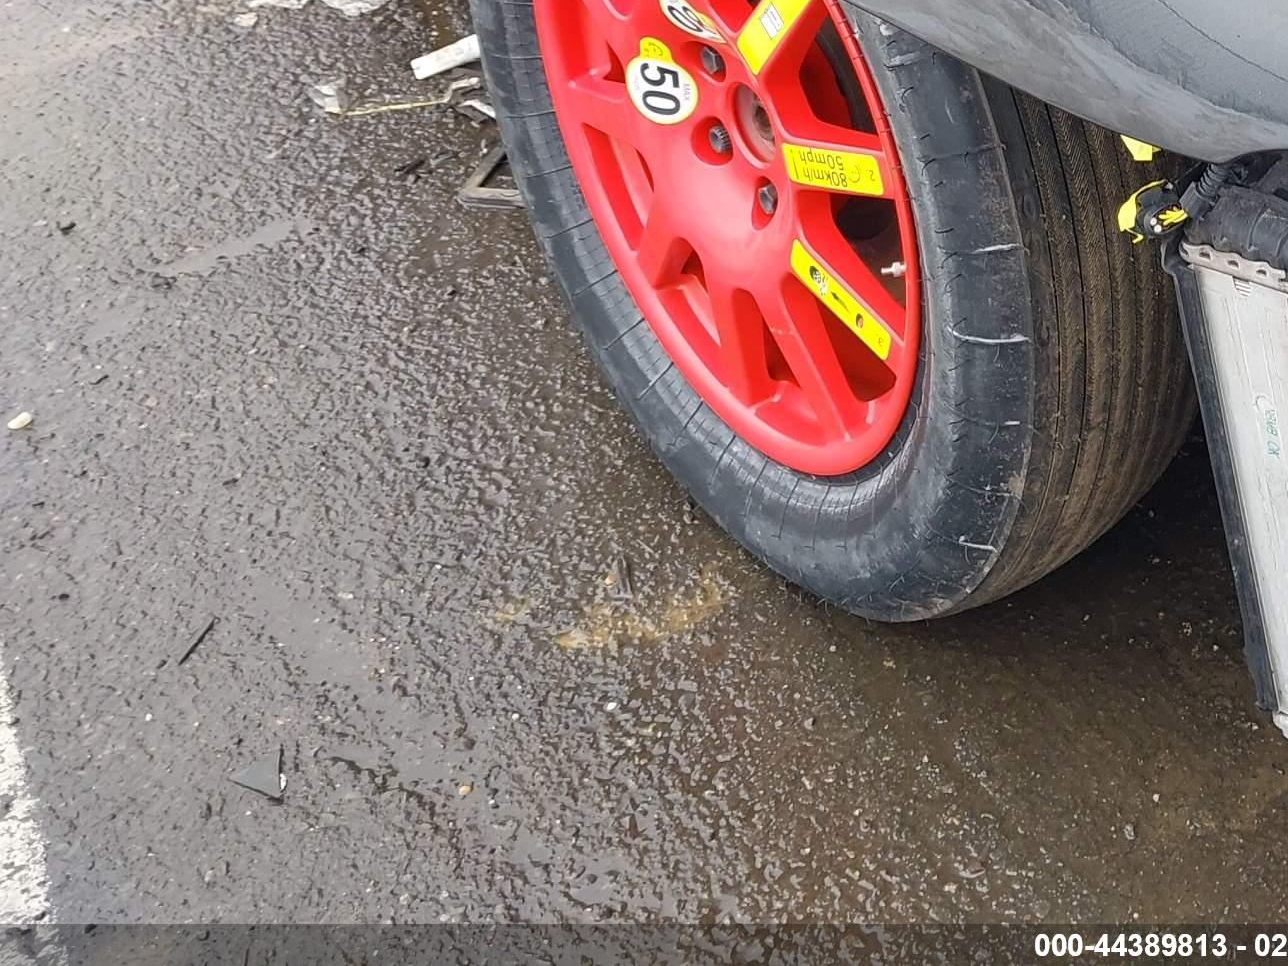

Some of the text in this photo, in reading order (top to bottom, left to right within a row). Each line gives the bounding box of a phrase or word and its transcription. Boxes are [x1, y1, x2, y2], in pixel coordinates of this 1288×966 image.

[639, 62, 681, 116] 50
[799, 146, 845, 171] 50mph
[803, 167, 848, 188] 80km/h
